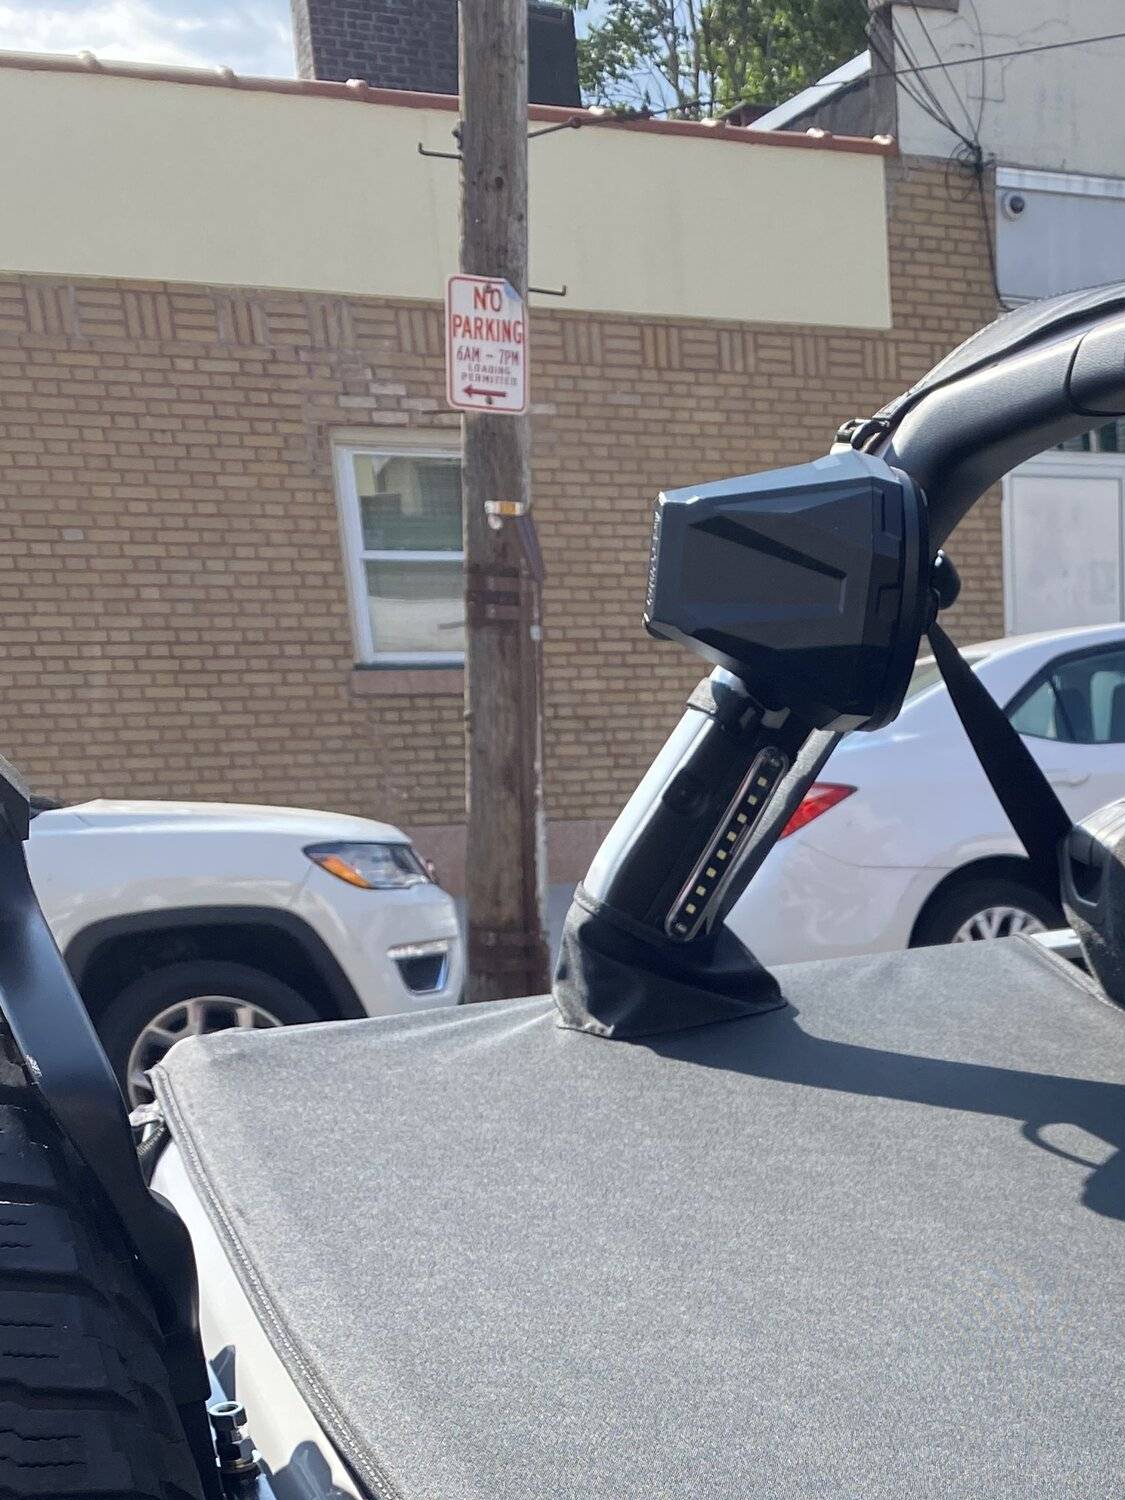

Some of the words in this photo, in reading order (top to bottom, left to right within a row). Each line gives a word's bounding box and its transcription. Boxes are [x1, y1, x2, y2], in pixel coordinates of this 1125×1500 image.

[473, 286, 502, 312] NO
[453, 314, 522, 344] PARKING
[456, 345, 480, 362] 6AM
[500, 349, 519, 366] 7PM
